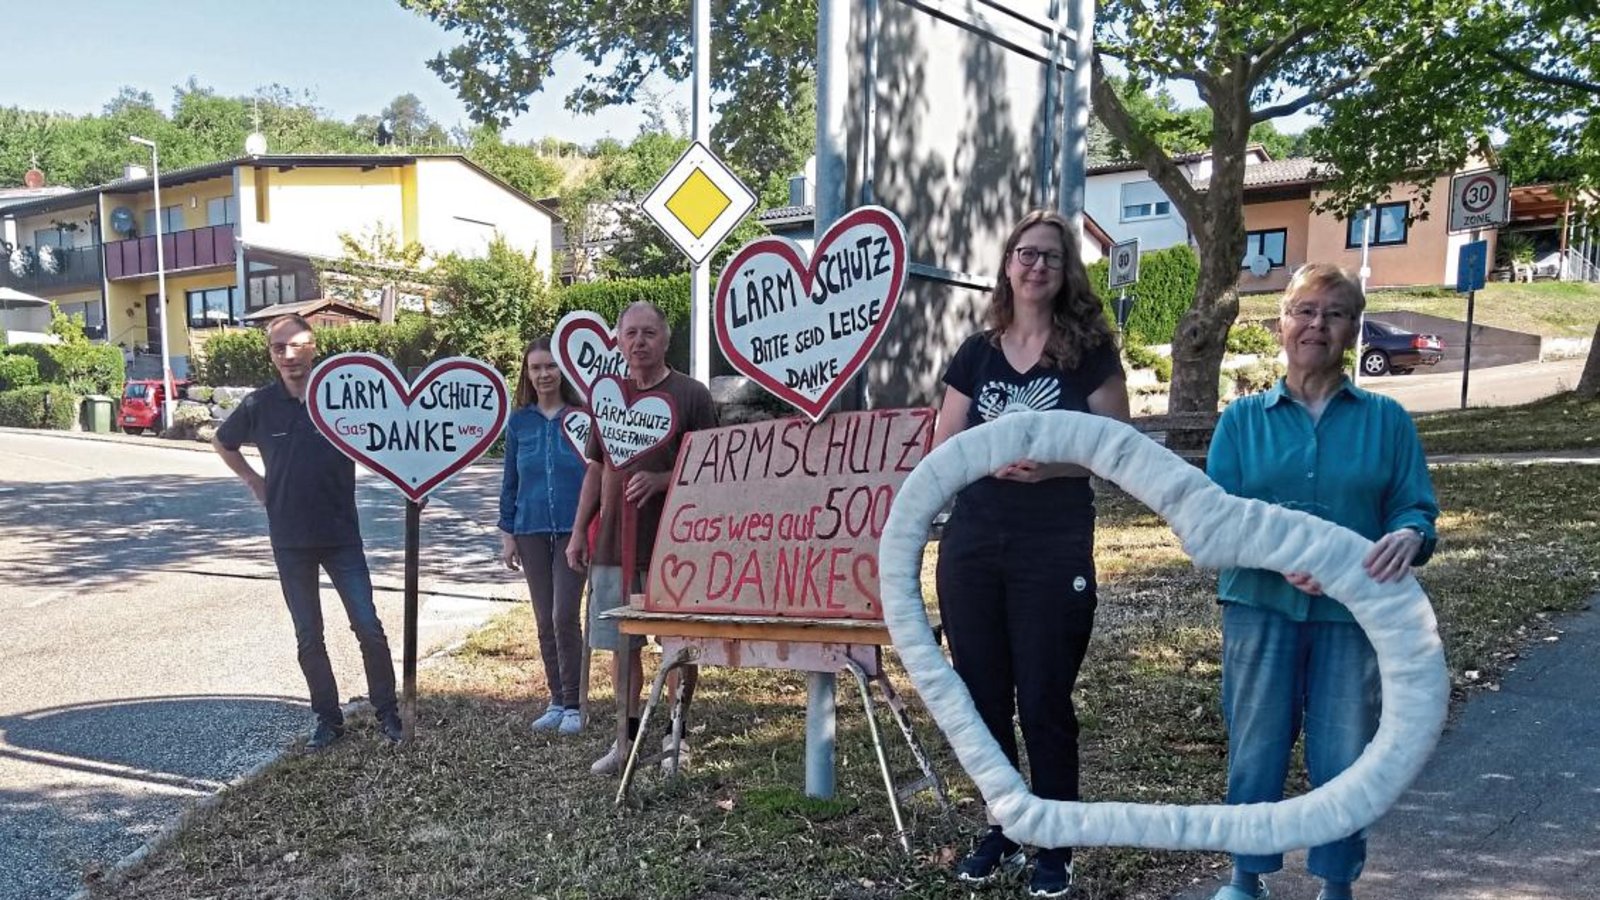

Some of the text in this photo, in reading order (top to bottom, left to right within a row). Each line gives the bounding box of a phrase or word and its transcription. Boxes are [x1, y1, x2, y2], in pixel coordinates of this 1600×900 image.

[1468, 185, 1489, 204] 30
[1463, 212, 1491, 226] ZONE
[730, 236, 891, 329] LÄRM SCHUTZ
[795, 327, 825, 353] SEID
[829, 299, 881, 340] LEISE
[577, 341, 630, 376] DANK
[785, 358, 839, 389] DANKE
[325, 373, 494, 410] LÄRM SCHUTZ
[335, 417, 484, 452] Gas DANKE weg
[608, 443, 637, 458] DANKE
[670, 503, 722, 543] Gas
[728, 510, 774, 541] weg
[778, 505, 822, 541] auf
[706, 545, 854, 610] DANKE
